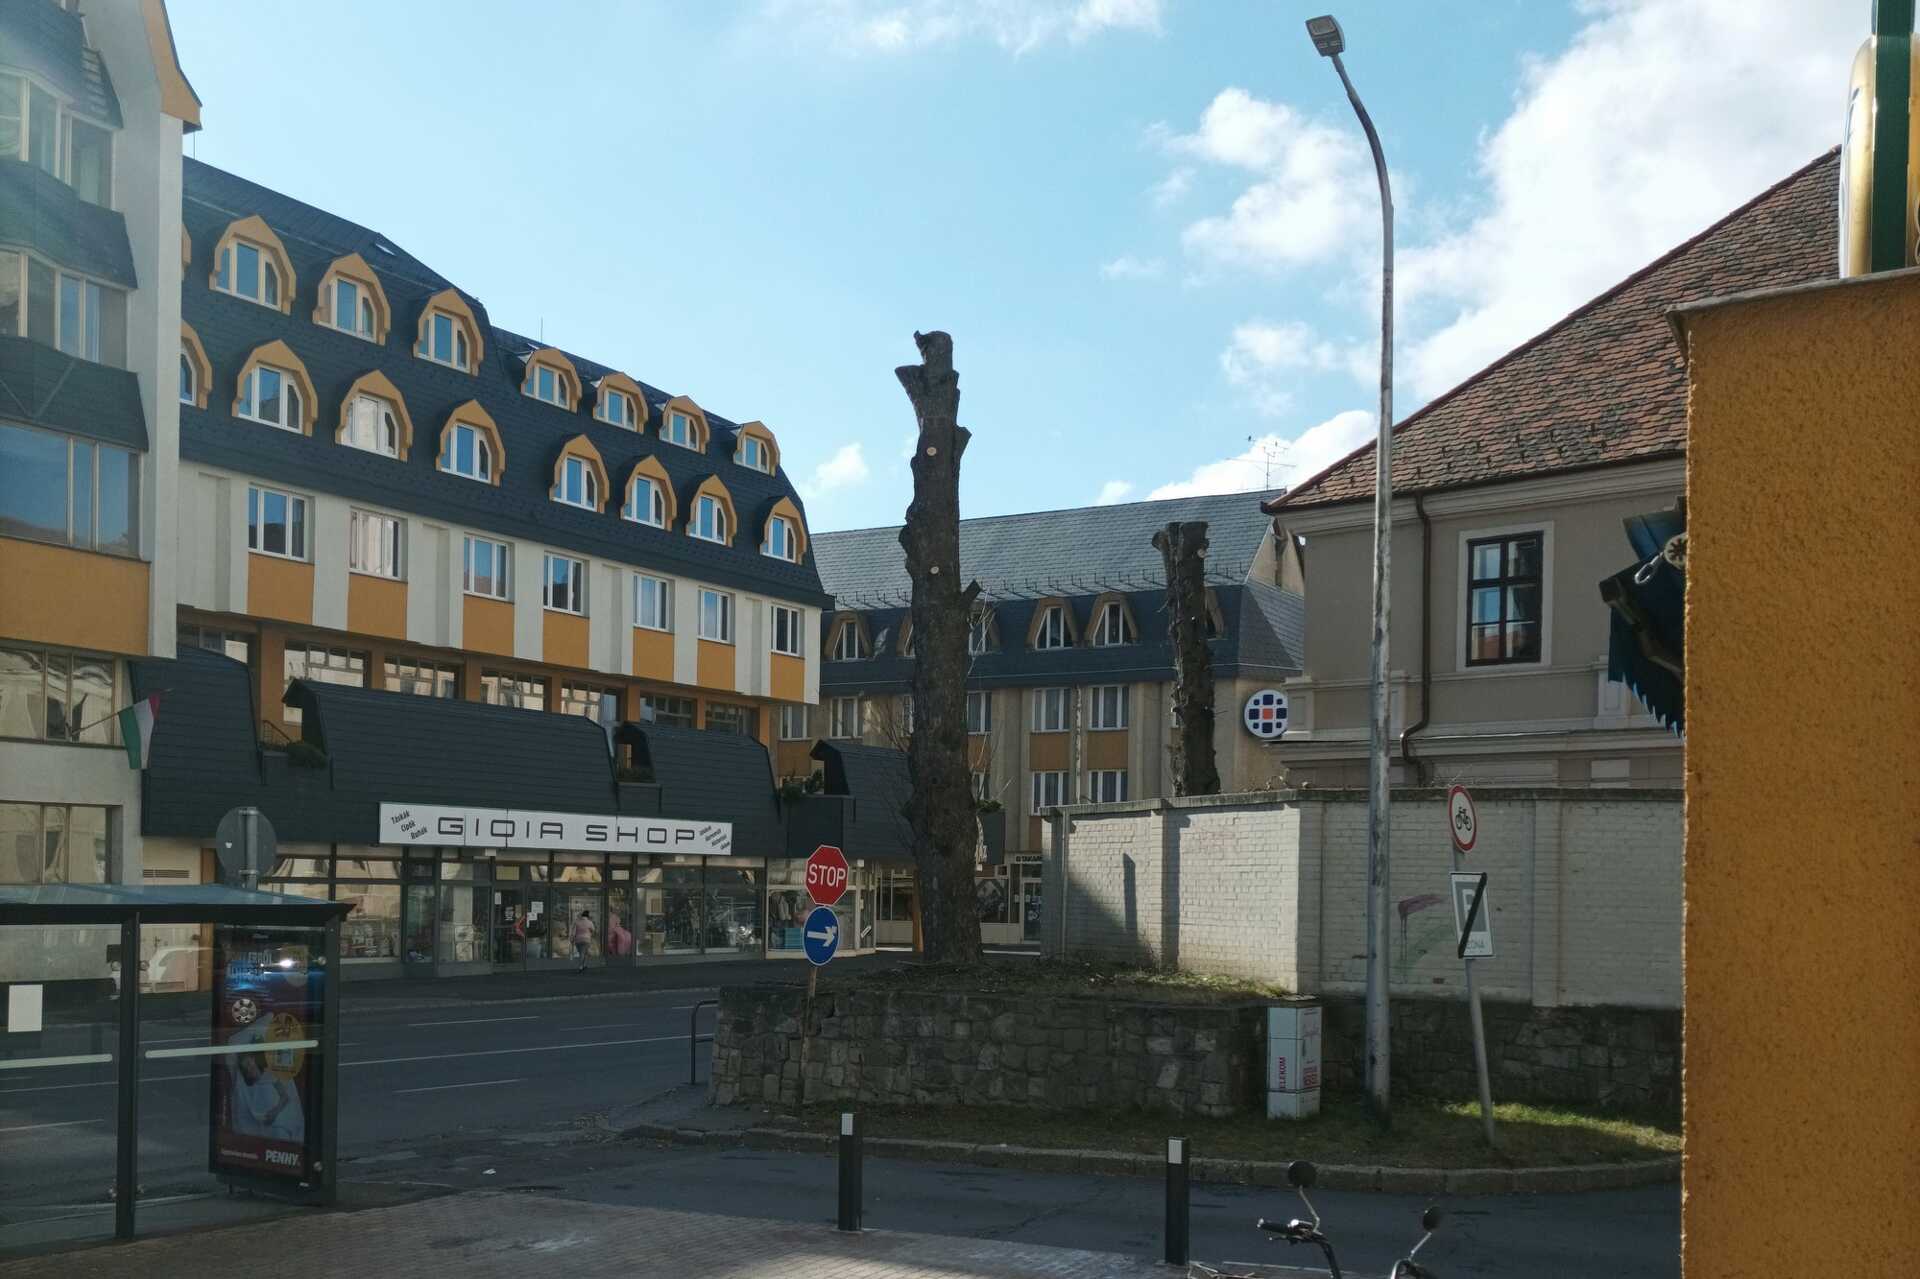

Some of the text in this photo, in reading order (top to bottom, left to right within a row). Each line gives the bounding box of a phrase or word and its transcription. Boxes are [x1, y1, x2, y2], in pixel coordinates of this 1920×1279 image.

[438, 816, 563, 840] GIOIA
[585, 824, 695, 845] SHOP
[808, 863, 846, 888] STOP
[1462, 888, 1477, 920] P
[265, 1149, 299, 1166] PENNY
